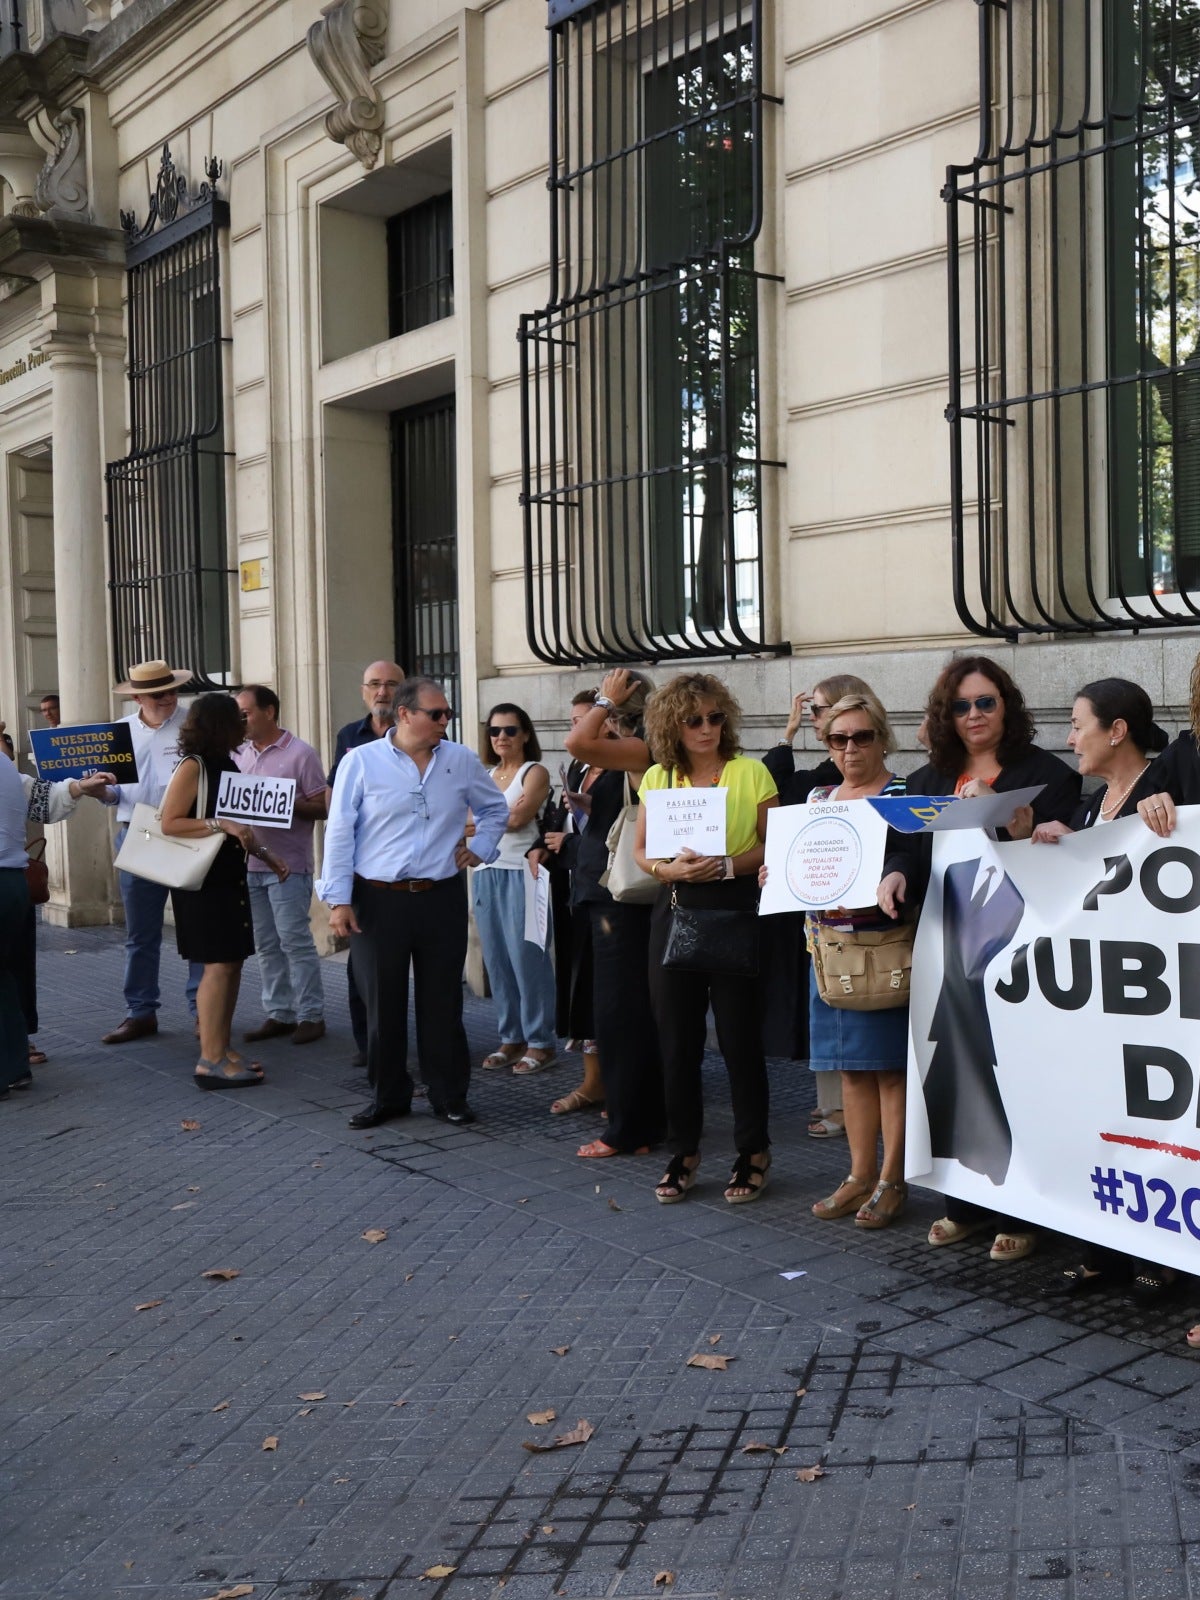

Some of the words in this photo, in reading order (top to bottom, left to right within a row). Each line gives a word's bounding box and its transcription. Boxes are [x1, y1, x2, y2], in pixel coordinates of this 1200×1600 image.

[50, 731, 114, 747] NUESTROS
[60, 743, 110, 757] FONDOS
[40, 752, 132, 770] SECUESTRADOS
[219, 777, 294, 816] Justicia!
[666, 798, 707, 808] PASARELA
[682, 812, 702, 821] RETA
[806, 846, 850, 854] PROCURADORES
[802, 856, 843, 864] MUTUALISTAS
